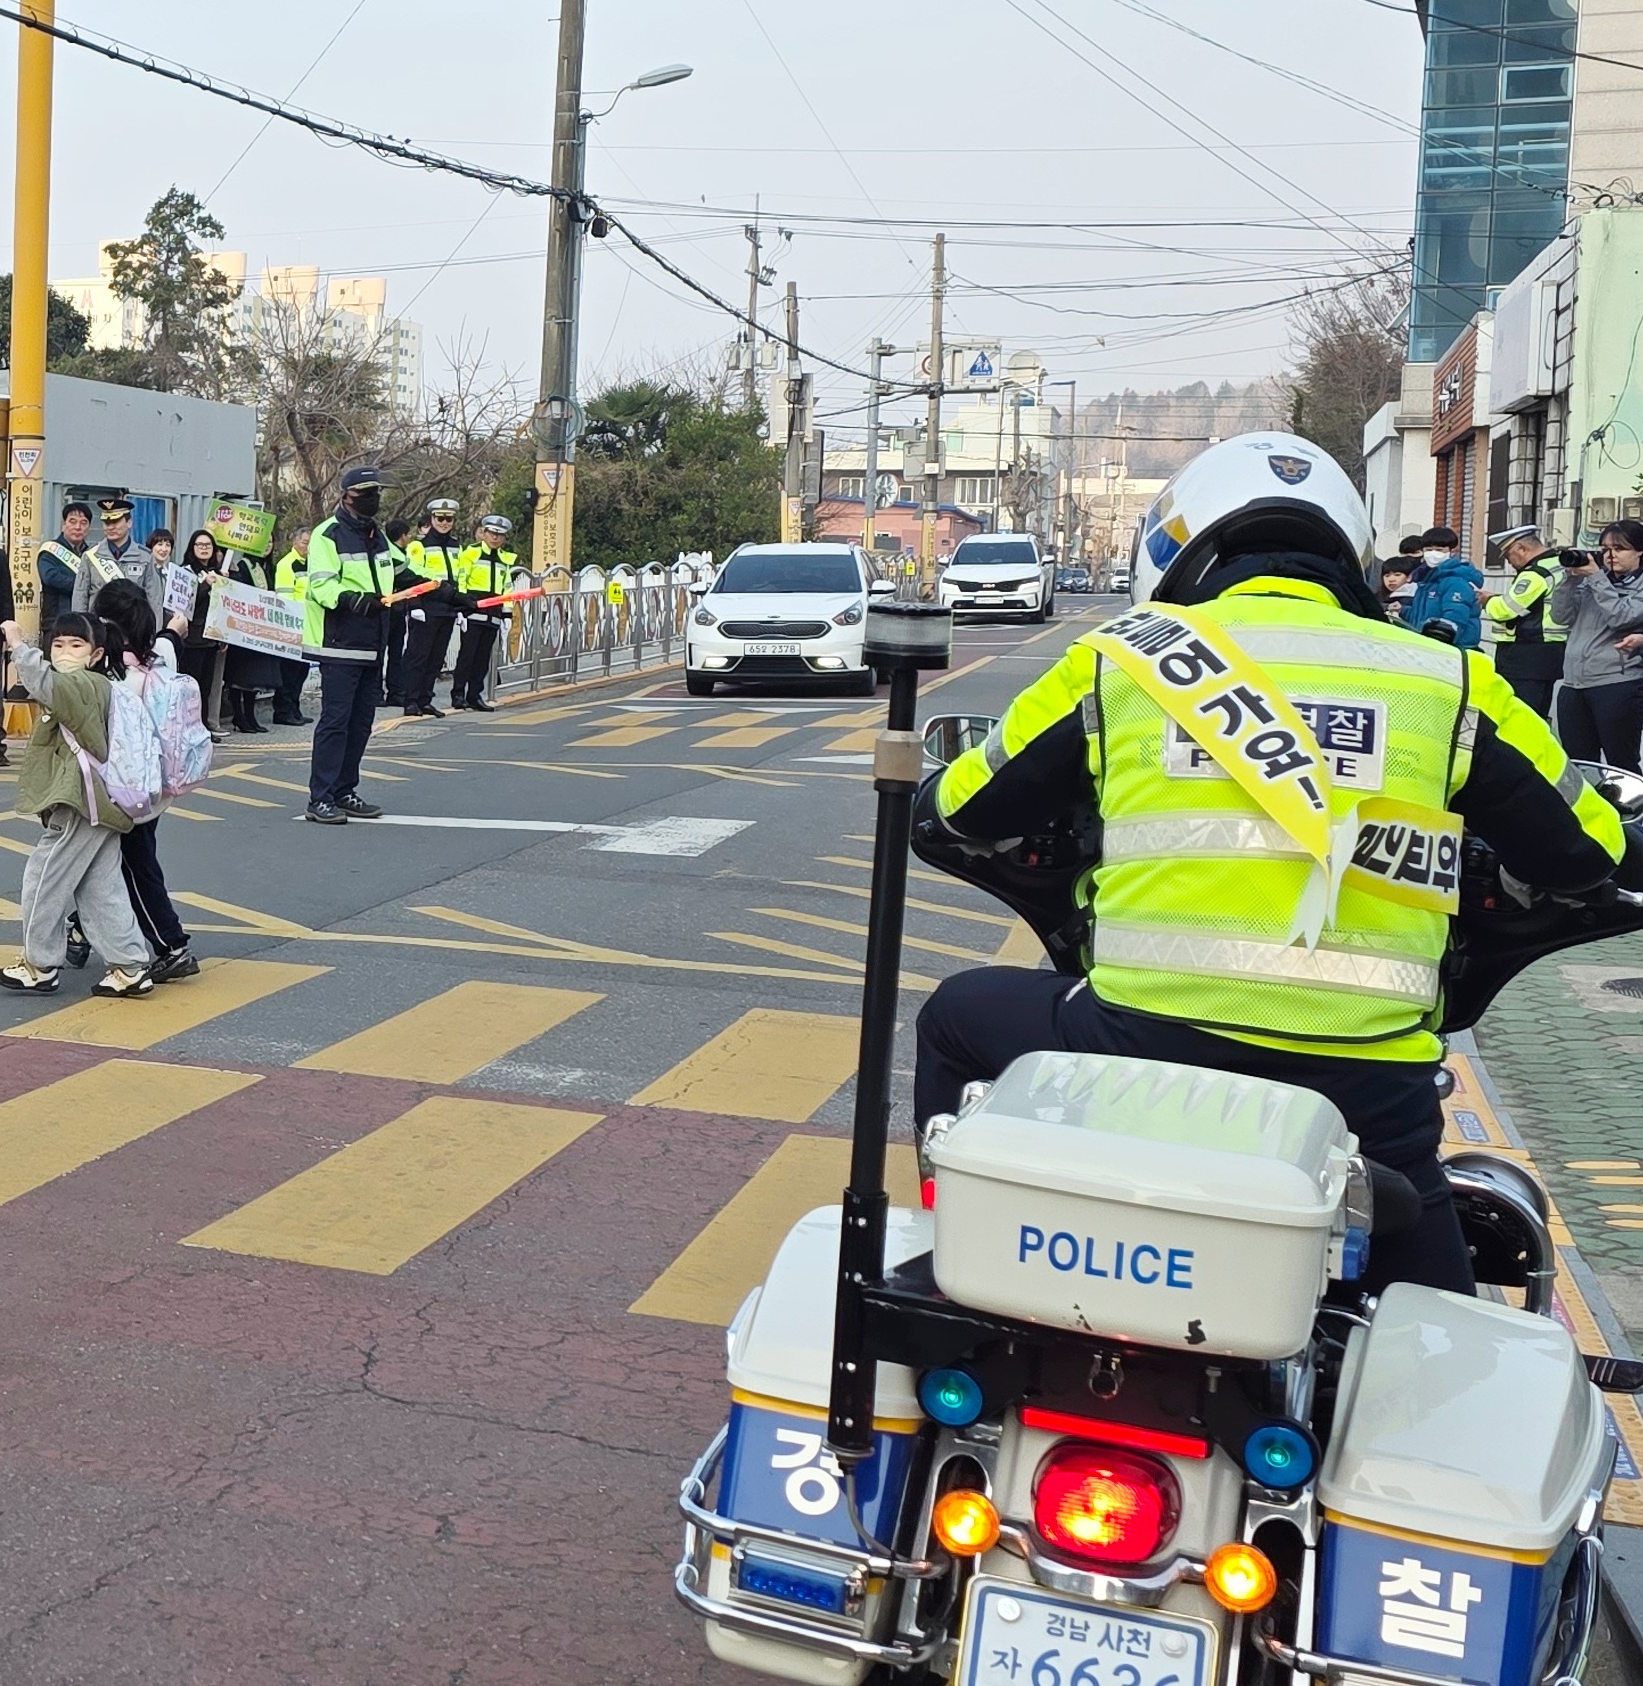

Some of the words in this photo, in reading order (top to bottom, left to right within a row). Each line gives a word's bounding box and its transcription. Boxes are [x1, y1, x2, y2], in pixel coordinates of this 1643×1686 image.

[22, 485, 32, 520] 어린이
[772, 645, 796, 653] 2378
[1199, 685, 1325, 810] 가요!
[1018, 1224, 1195, 1291] POLICE
[770, 1429, 845, 1516] 경
[1046, 1612, 1090, 1643] 경남
[1098, 1622, 1151, 1659] 사천
[1380, 1557, 1483, 1658] 찰
[990, 1646, 1022, 1680] 자
[1031, 1648, 1181, 1686] 66
